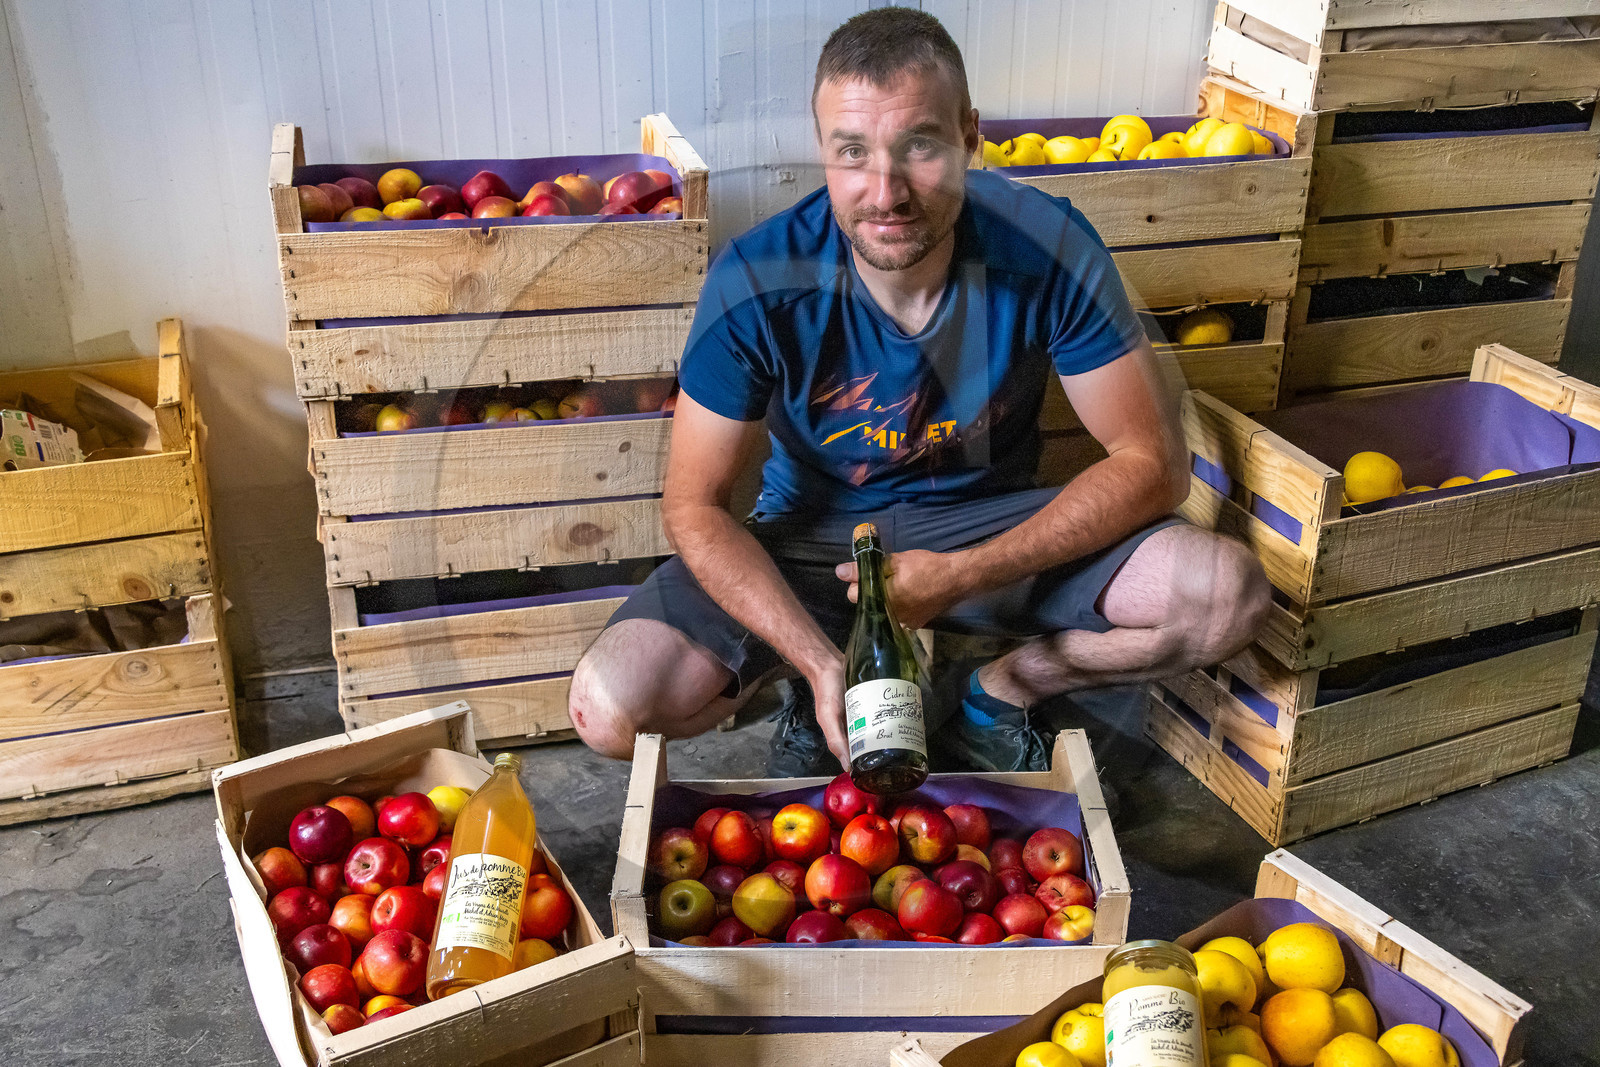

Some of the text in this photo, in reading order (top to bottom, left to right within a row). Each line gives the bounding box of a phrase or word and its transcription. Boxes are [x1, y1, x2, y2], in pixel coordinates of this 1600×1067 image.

[12, 434, 27, 456] BIO
[883, 687, 905, 701] Cidre
[876, 729, 893, 740] Brut
[452, 865, 468, 888] Jus
[471, 865, 479, 874] de
[479, 863, 516, 878] pomme
[1129, 991, 1186, 1016] Pomme Bio
